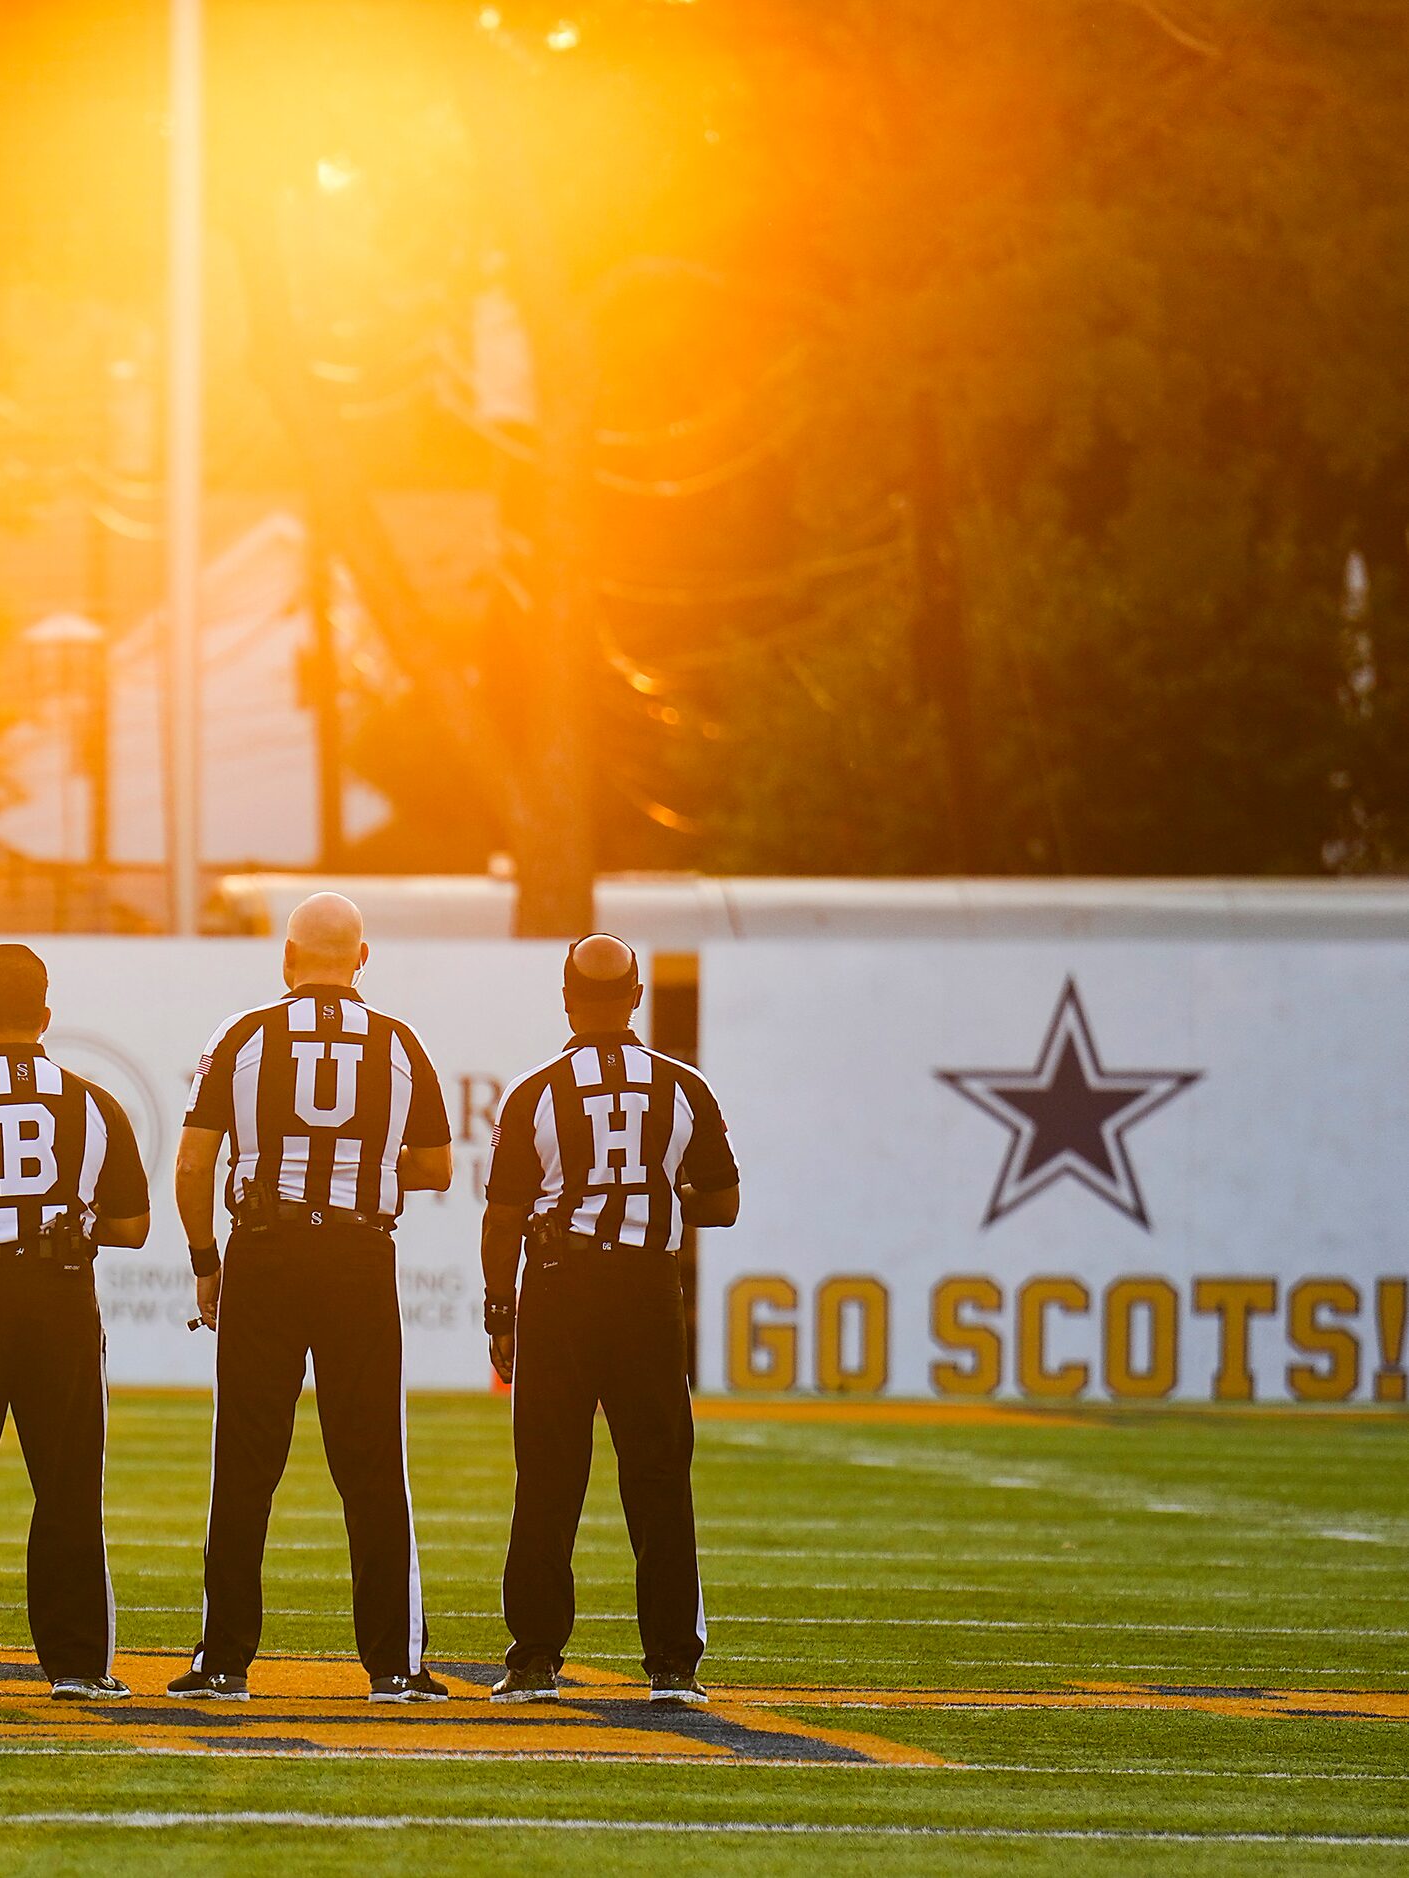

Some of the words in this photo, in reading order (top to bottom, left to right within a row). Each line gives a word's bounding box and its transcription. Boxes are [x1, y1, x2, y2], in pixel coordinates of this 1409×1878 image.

[291, 1041, 364, 1127] U
[583, 1091, 650, 1186] H
[724, 1274, 890, 1396] GO
[927, 1274, 1408, 1402] SCOTS!
